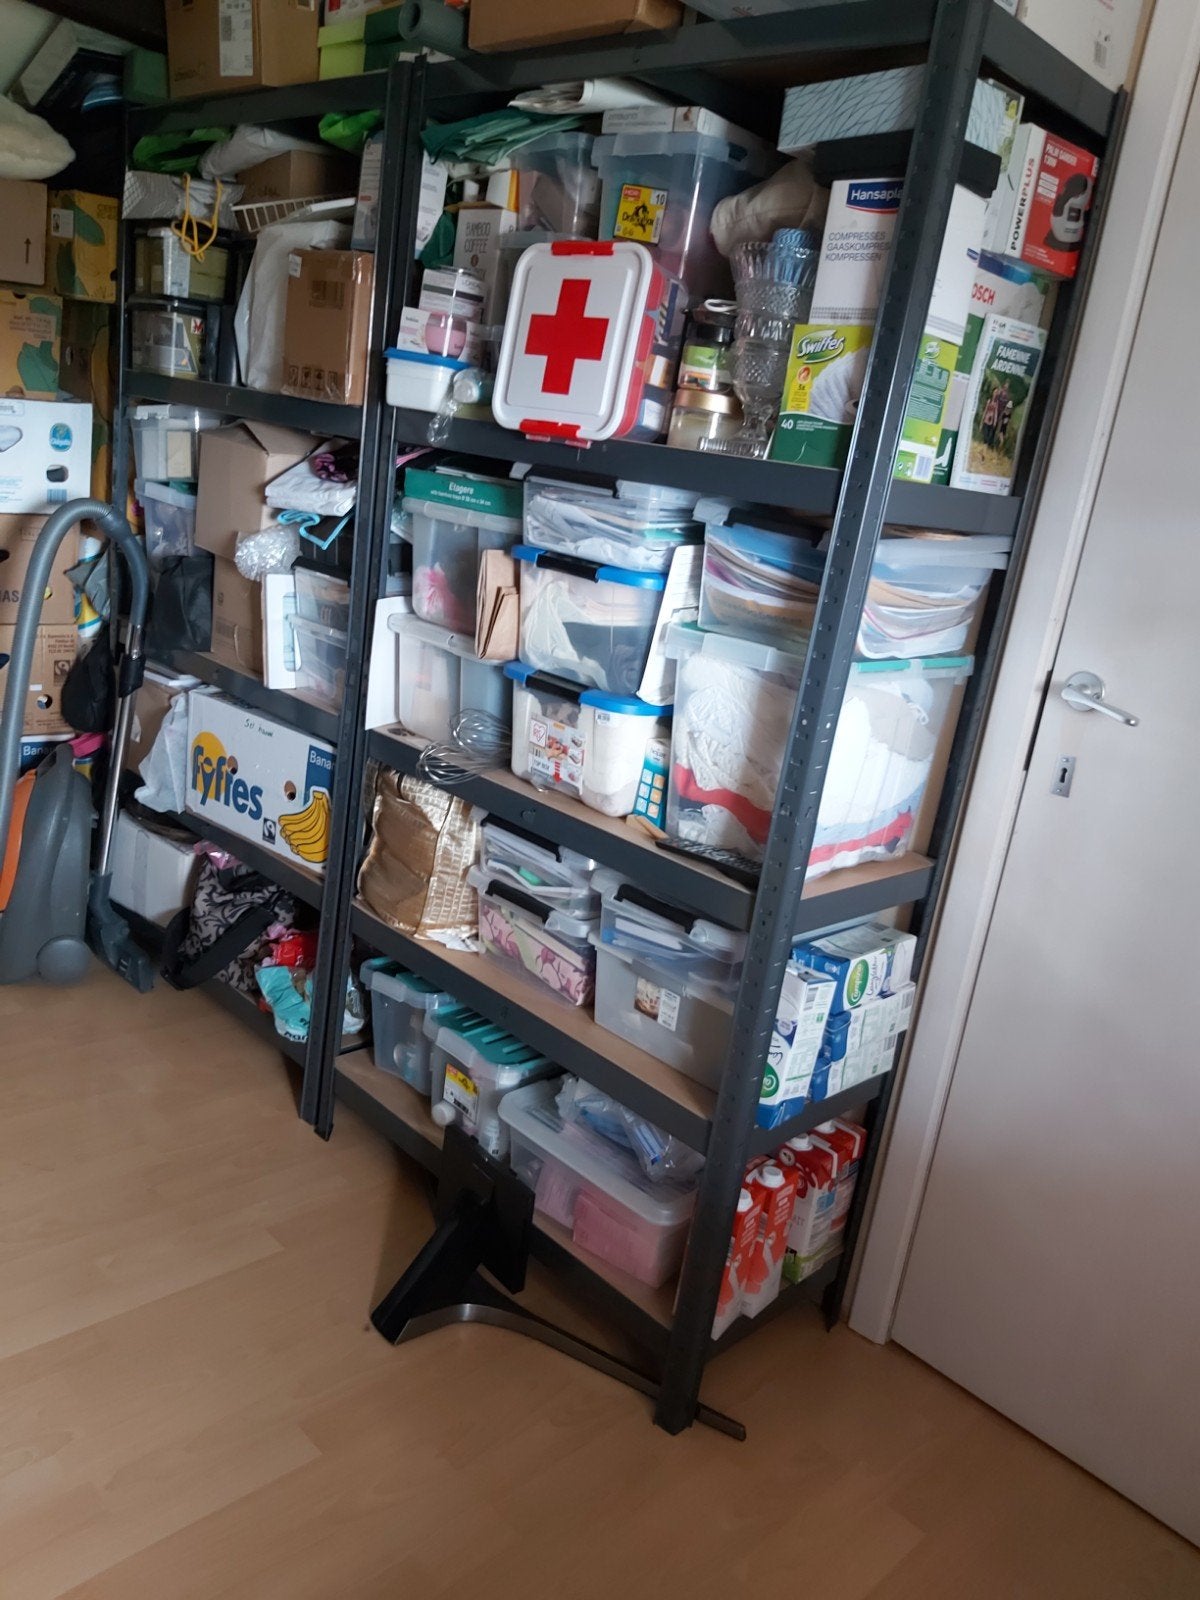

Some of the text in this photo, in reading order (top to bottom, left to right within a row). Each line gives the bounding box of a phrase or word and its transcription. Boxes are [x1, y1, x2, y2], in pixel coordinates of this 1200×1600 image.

[850, 188, 906, 202] Hansapla
[1010, 157, 1035, 251] POWERPLUS
[828, 231, 886, 241] COMPRESSES
[824, 252, 882, 262] KOMPRESSEN
[970, 282, 996, 306] OSCH
[797, 335, 845, 358] Swiffer
[996, 344, 1032, 364] FAMENNE
[990, 358, 1028, 377] ARDENNE
[781, 418, 794, 430] 40
